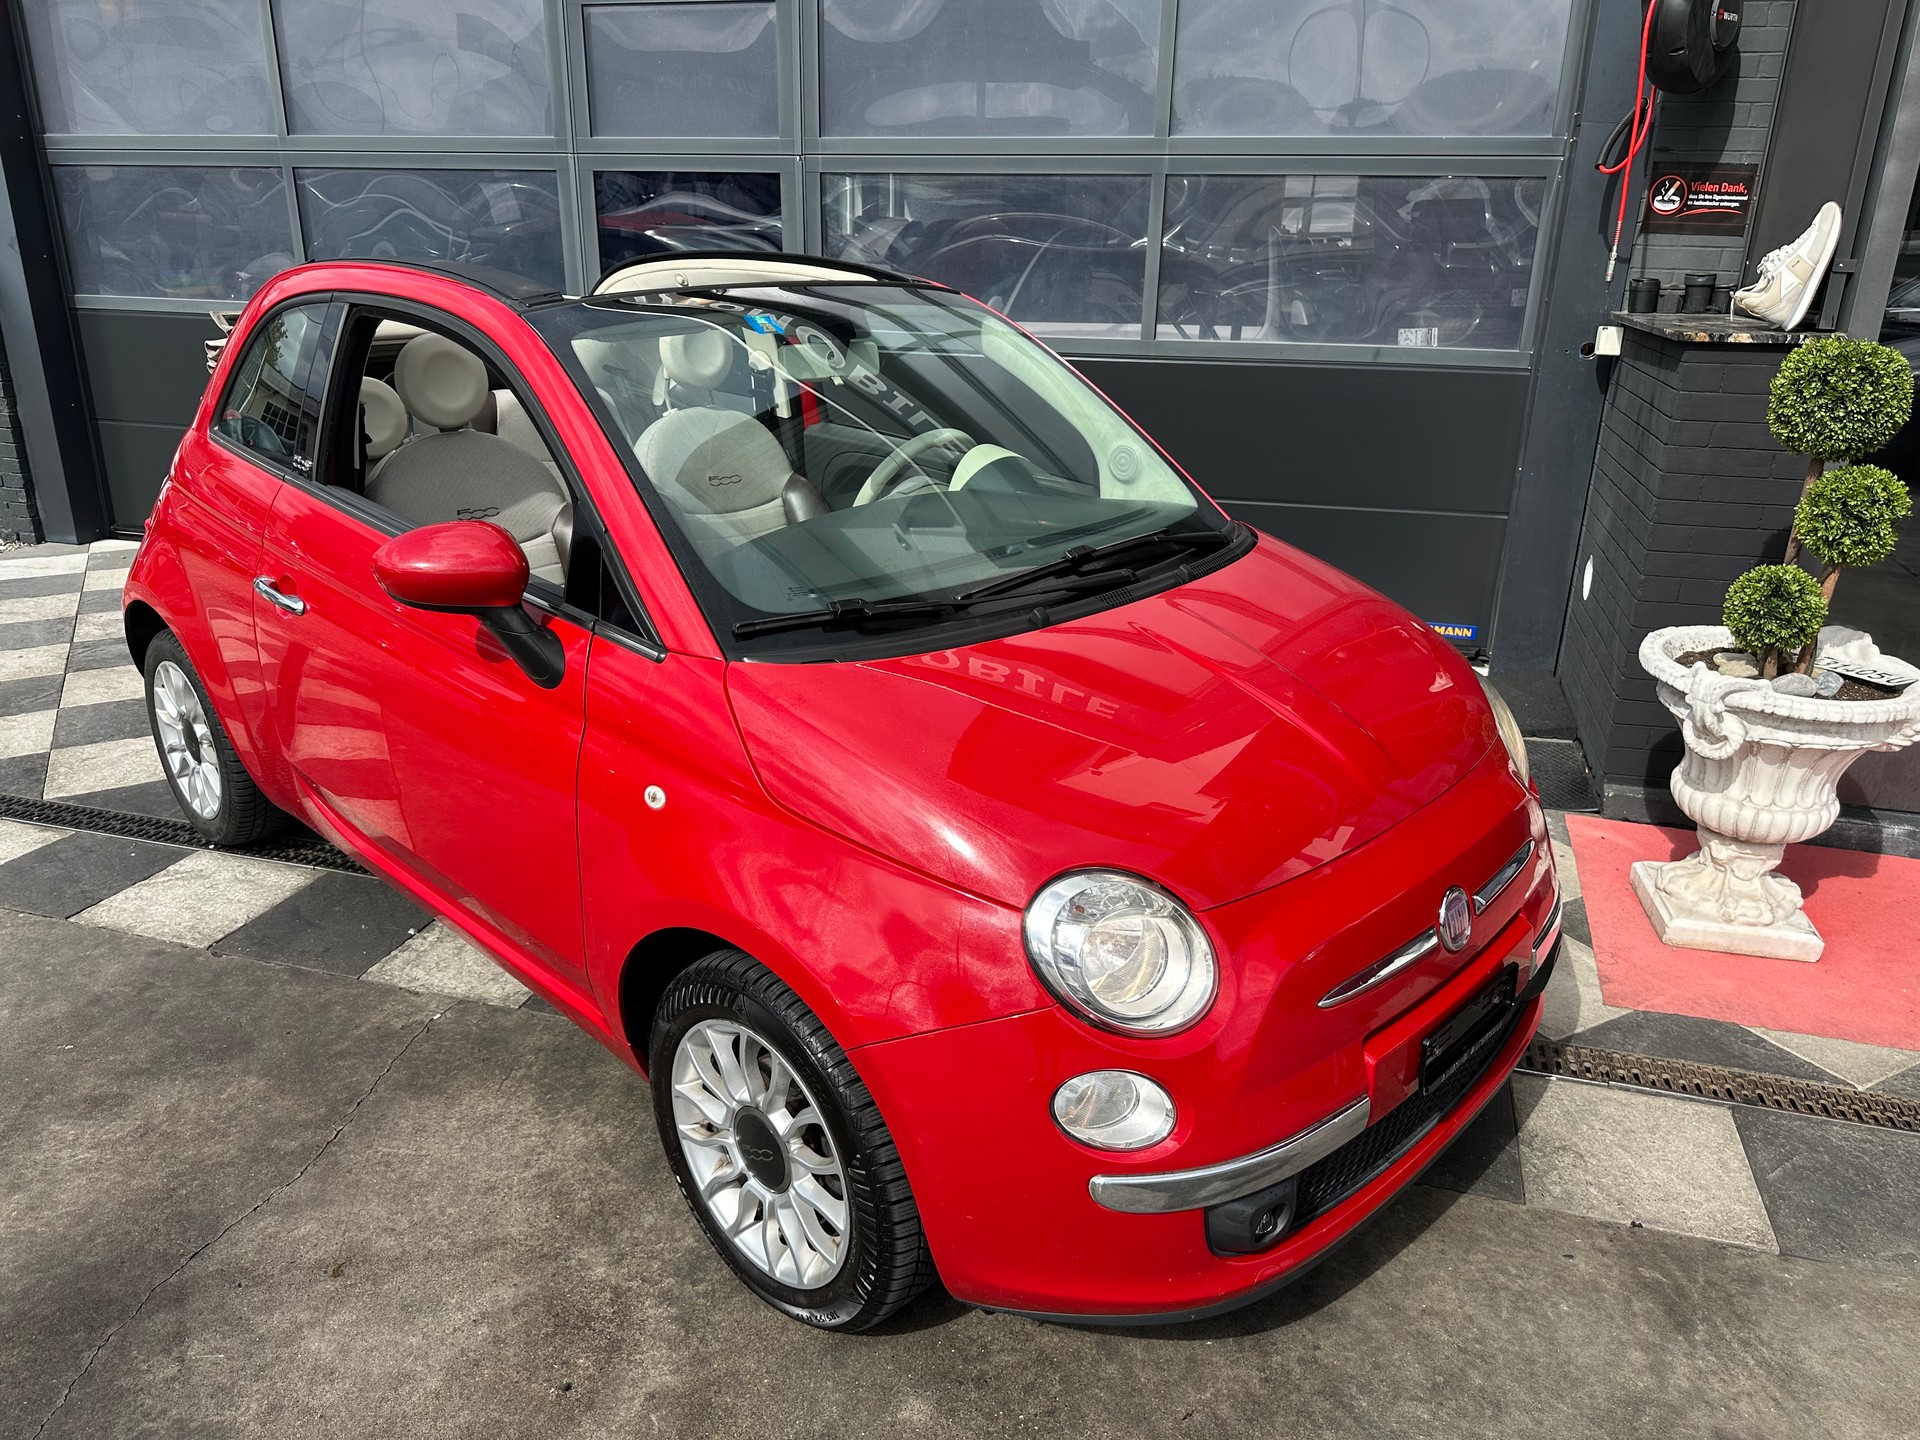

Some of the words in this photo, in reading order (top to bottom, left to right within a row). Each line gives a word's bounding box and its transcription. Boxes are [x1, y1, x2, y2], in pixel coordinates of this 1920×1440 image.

[1691, 182, 1719, 192] Vielen
[1721, 182, 1748, 194] Dank,
[708, 474, 742, 487] 500
[456, 506, 501, 521] 500
[1430, 625, 1472, 638] MANN
